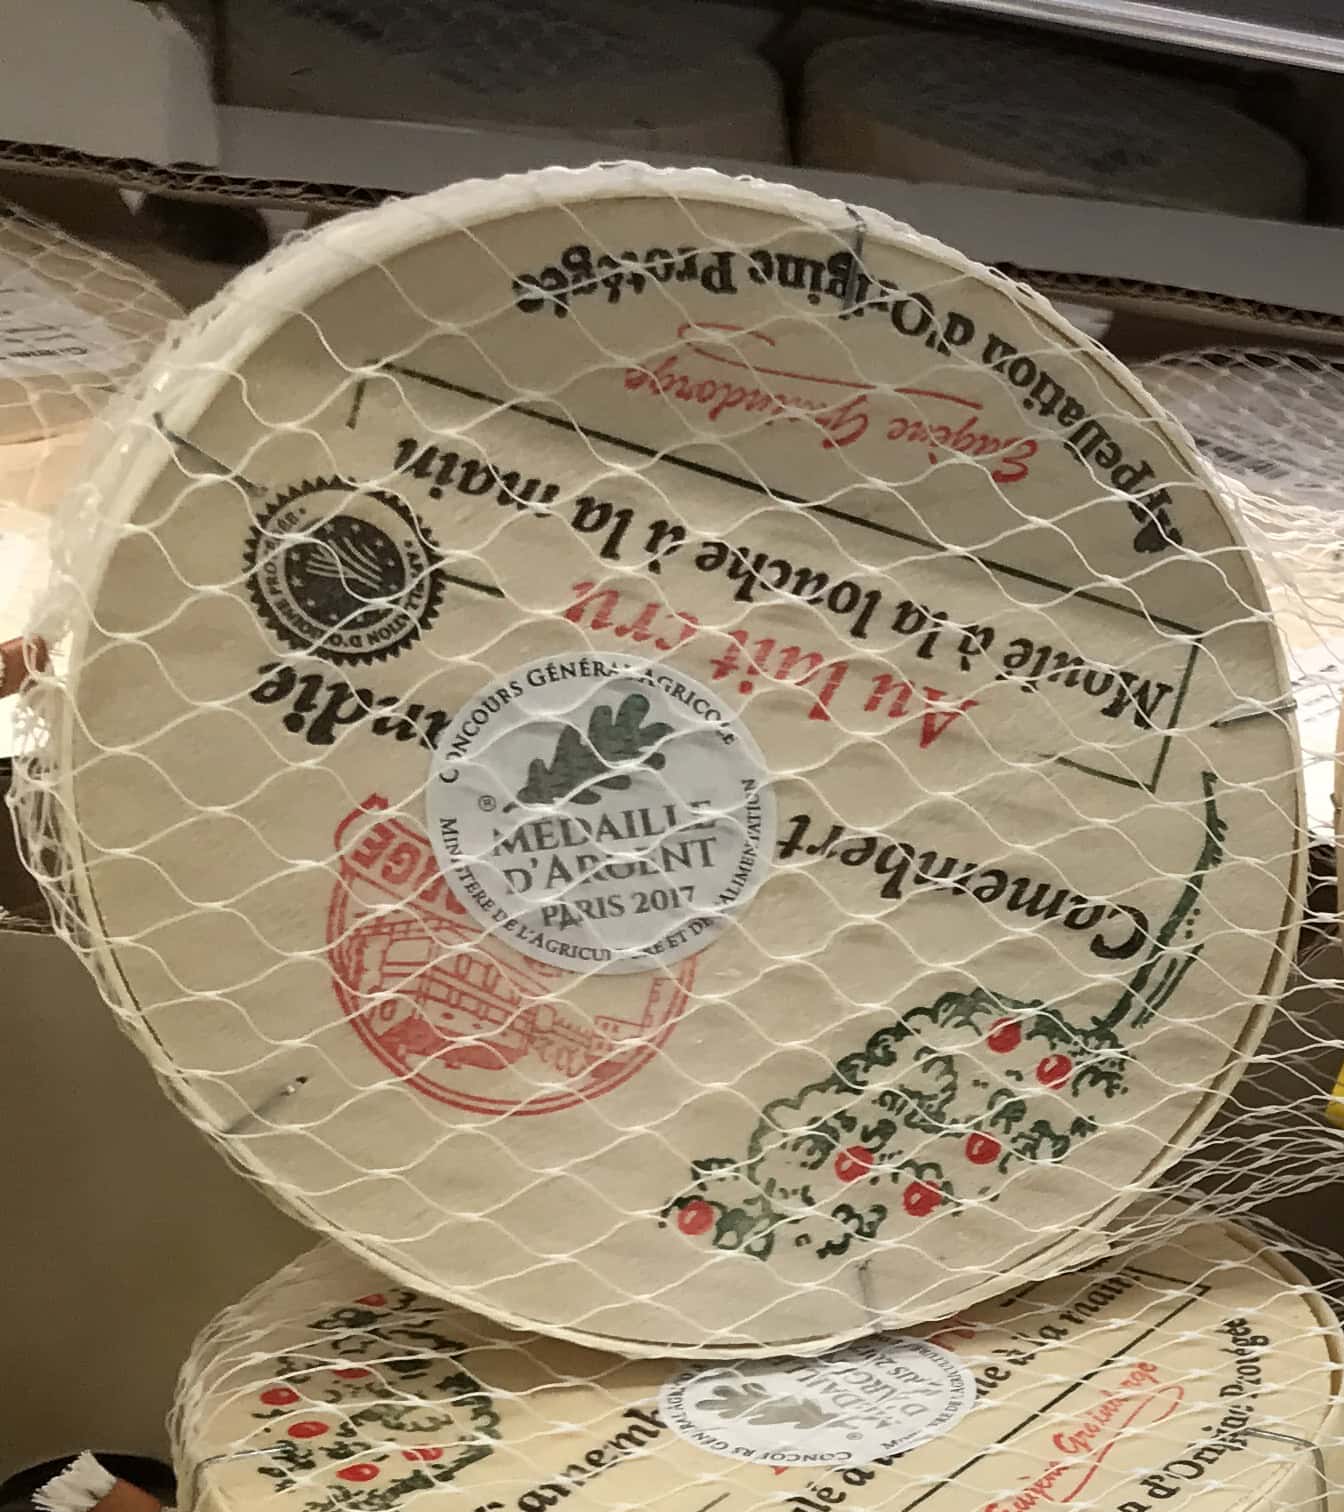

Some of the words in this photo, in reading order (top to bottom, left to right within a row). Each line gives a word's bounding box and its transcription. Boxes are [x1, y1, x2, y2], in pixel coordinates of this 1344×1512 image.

[394, 437, 561, 520] main
[574, 497, 637, 560] la
[645, 519, 688, 575] à
[559, 581, 699, 652] cru
[697, 541, 882, 638] louche
[894, 600, 952, 661] la
[957, 630, 997, 673] à
[709, 628, 844, 722] lait
[862, 672, 981, 749] Au
[1000, 634, 1175, 731] Moulé
[541, 892, 626, 930] PARIS
[632, 885, 697, 916] 2017
[777, 815, 1150, 962] Camembert
